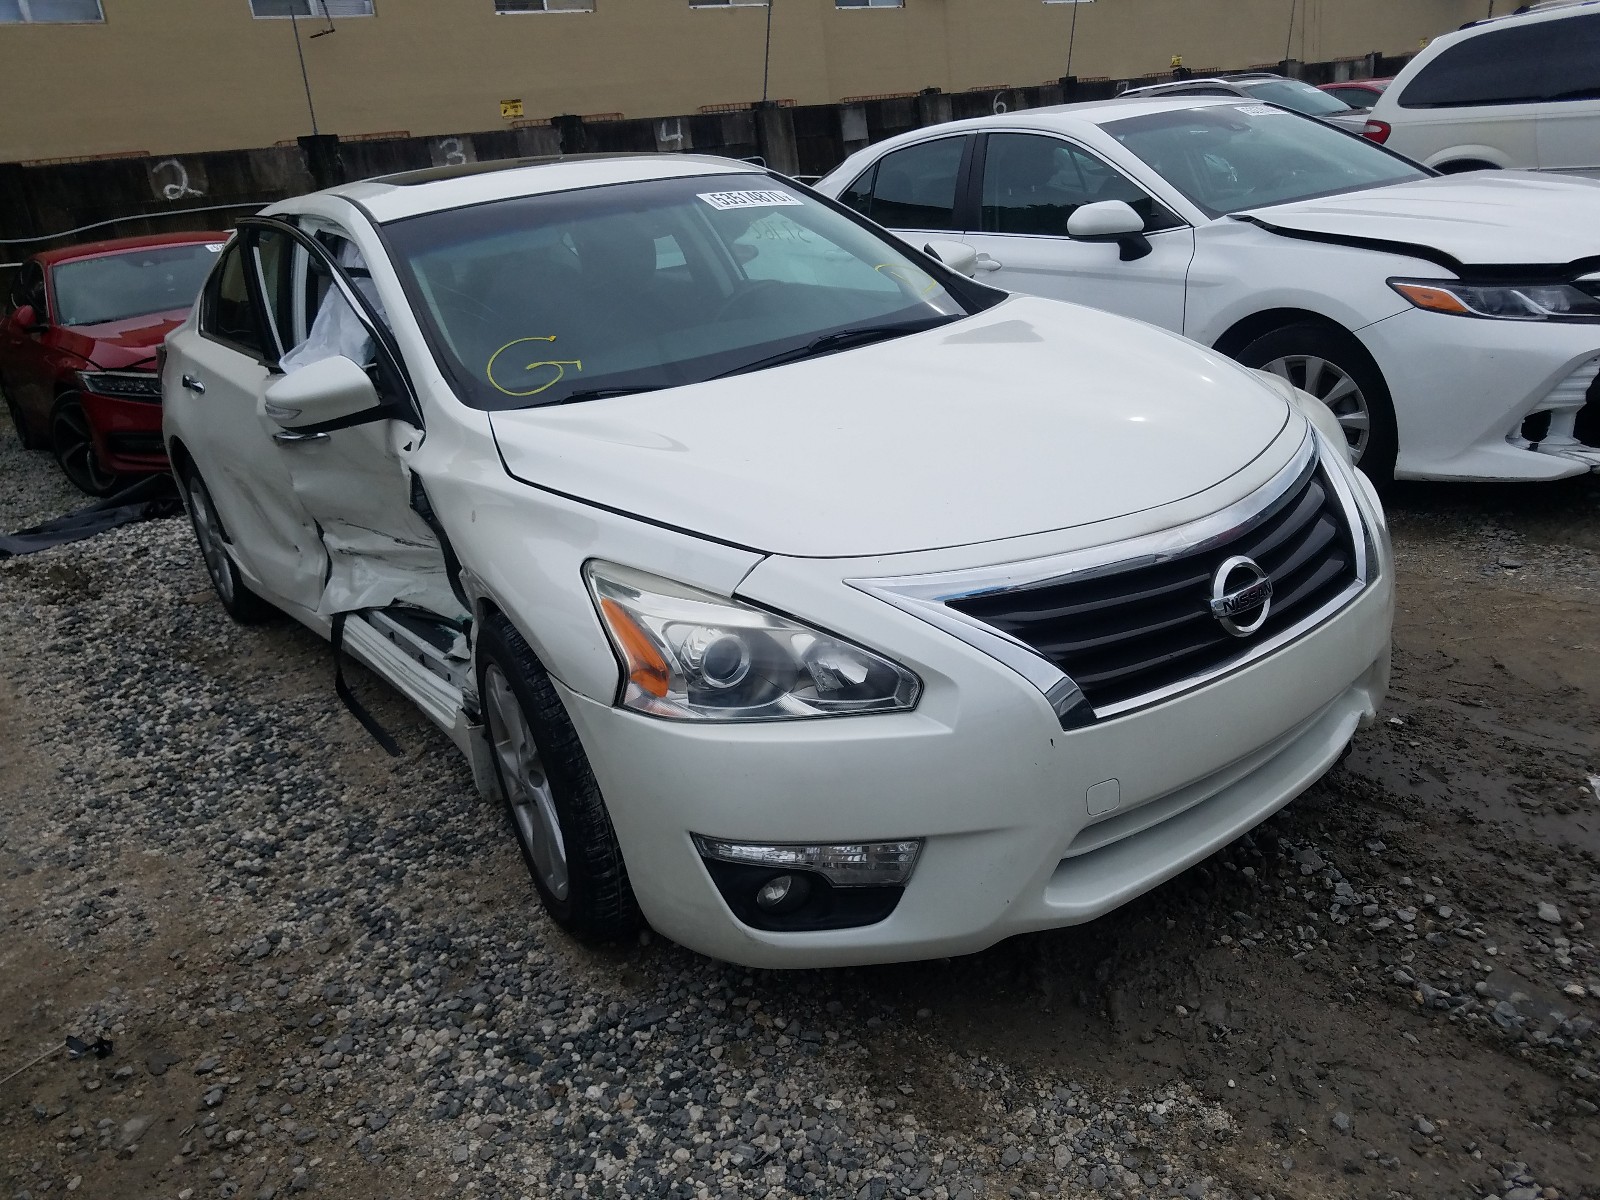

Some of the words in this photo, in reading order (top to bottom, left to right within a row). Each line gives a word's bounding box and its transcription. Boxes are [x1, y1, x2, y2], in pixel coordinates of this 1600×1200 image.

[992, 92, 1007, 115] 6
[660, 118, 684, 150] 4
[438, 138, 467, 166] 3
[152, 157, 205, 200] 2
[486, 335, 583, 397] G
[1222, 580, 1272, 614] NISSAN
